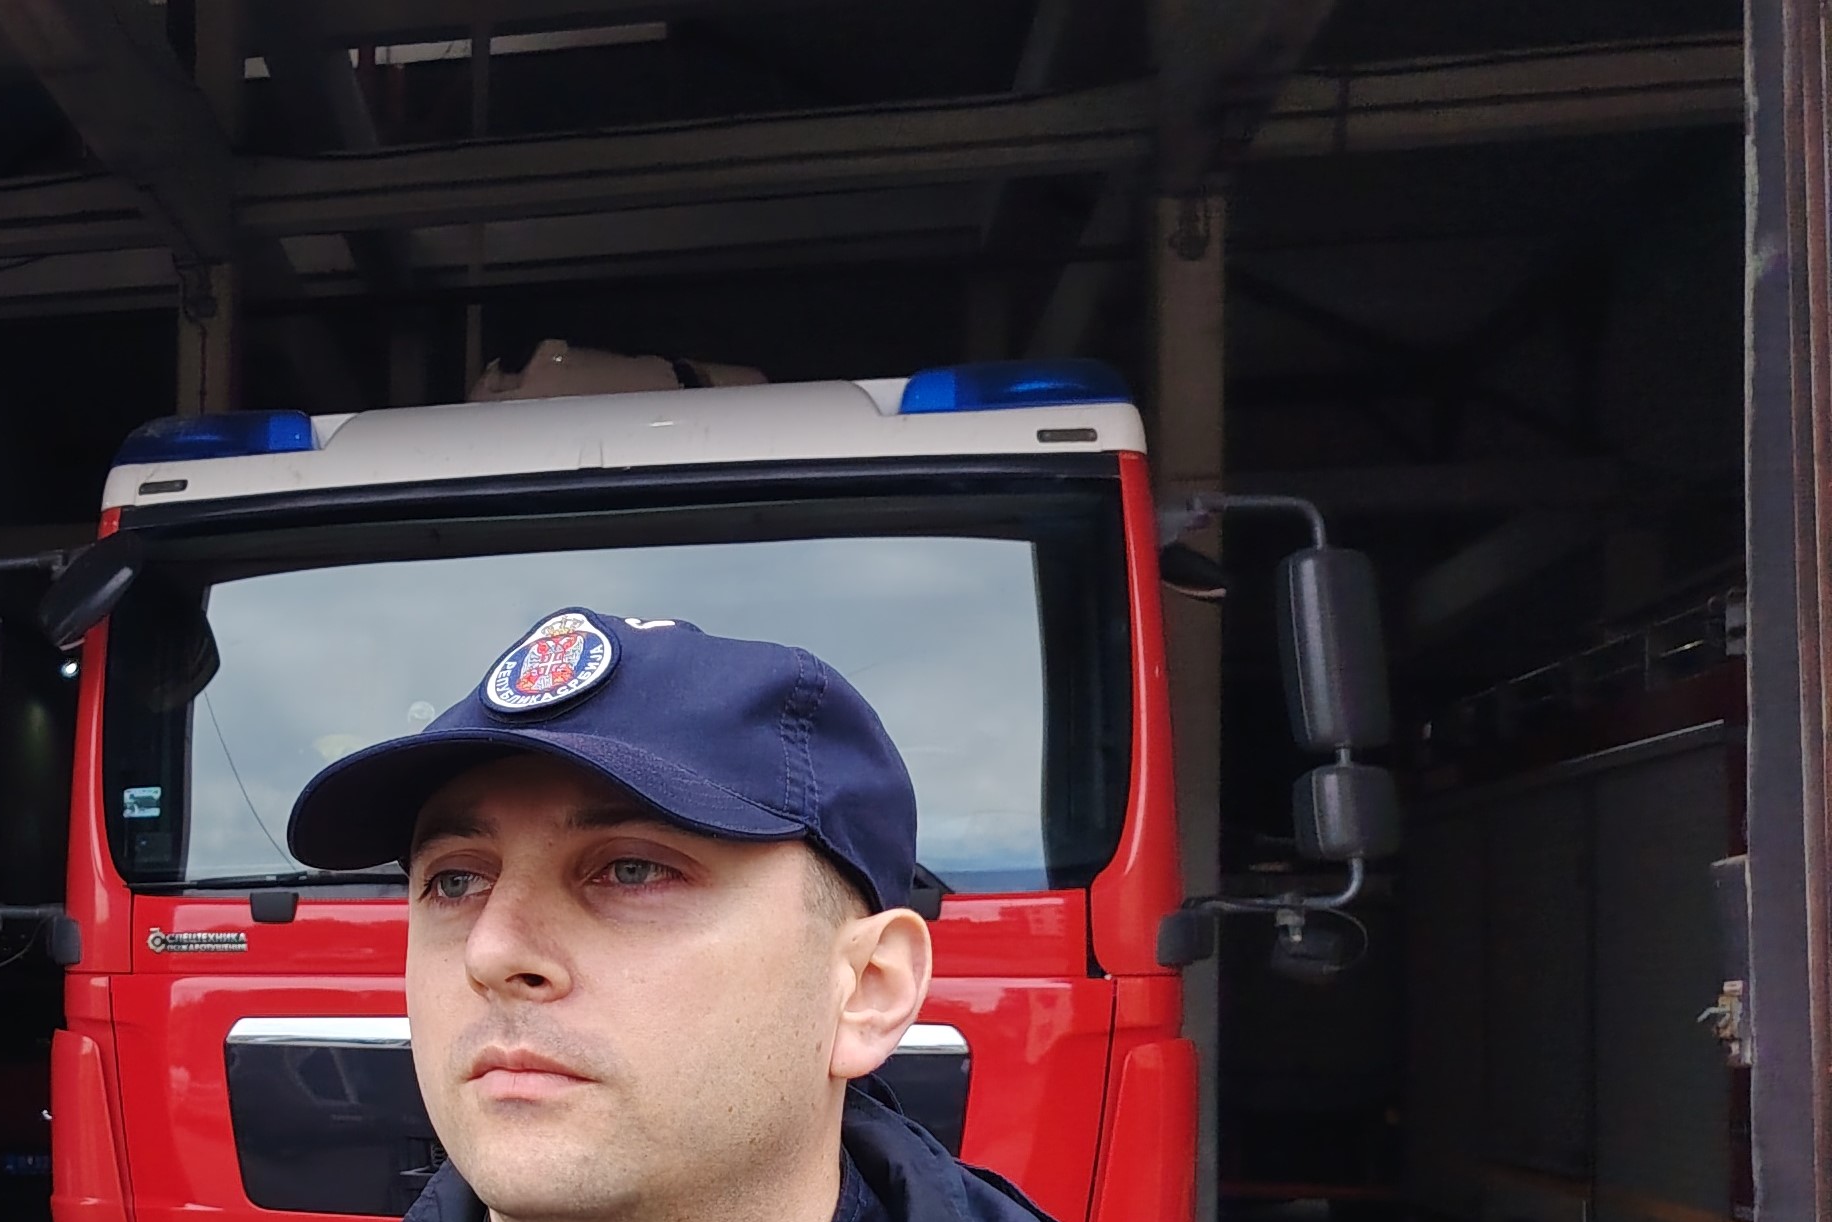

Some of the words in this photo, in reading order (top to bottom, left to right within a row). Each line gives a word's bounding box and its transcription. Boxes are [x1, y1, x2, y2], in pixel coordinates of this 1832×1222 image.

[495, 661, 552, 705] РЕПУБЛИКА
[556, 644, 605, 697] СРБИЈА
[166, 933, 246, 943] СПЕЦТЕХНИКА
